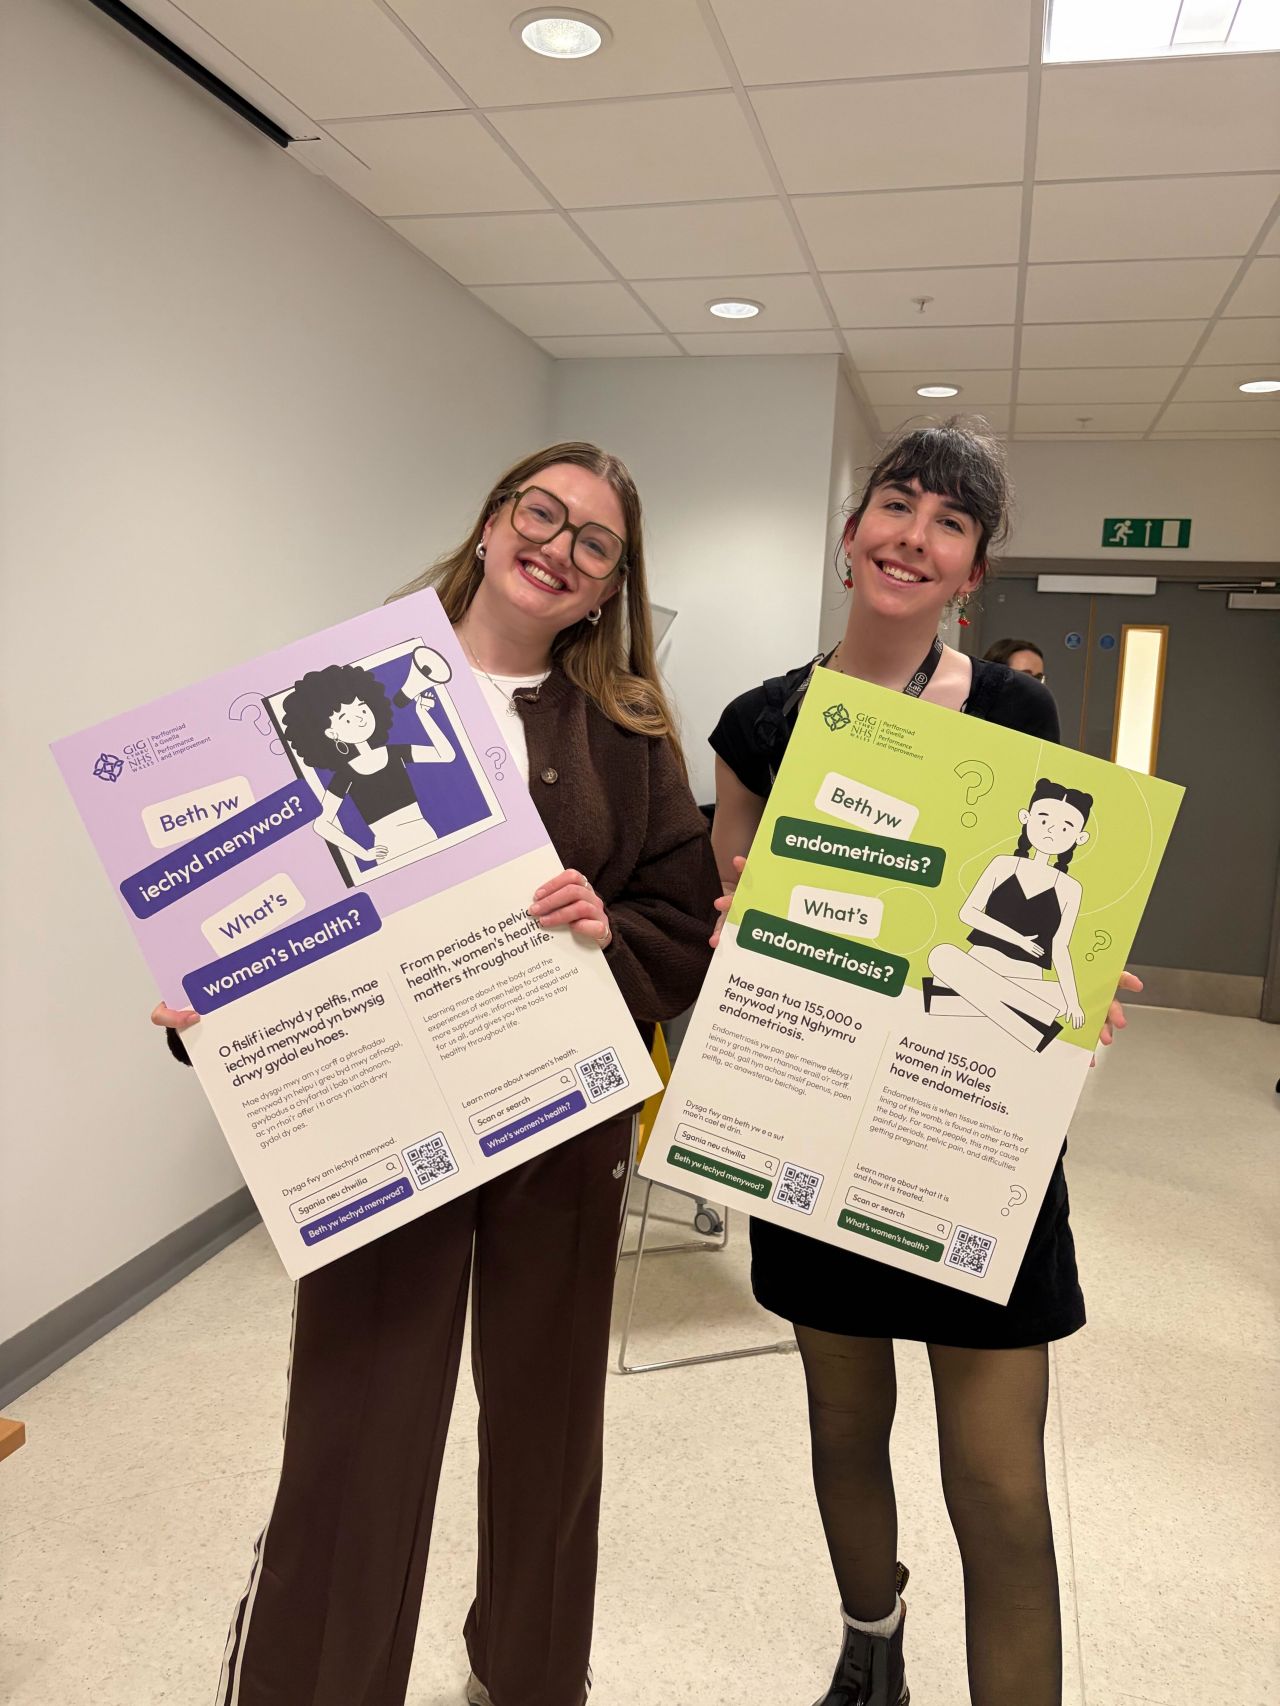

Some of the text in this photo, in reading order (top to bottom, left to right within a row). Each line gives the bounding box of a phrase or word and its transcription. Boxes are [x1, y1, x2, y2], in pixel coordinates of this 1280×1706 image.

[151, 722, 186, 742] Perfformiad
[850, 724, 873, 739] NHS
[856, 712, 877, 726] GIG
[882, 721, 916, 736] Perfformiad
[885, 728, 905, 739] Gwella
[123, 739, 147, 755] GIG
[156, 736, 194, 755] Performance
[159, 734, 180, 745] Gwella
[160, 752, 173, 761] and
[878, 734, 913, 750] Performance
[128, 752, 152, 769] NHS
[159, 796, 238, 833] Beth yw
[830, 787, 902, 828] Beth yw
[138, 796, 303, 902] iechyd menywod?
[785, 834, 931, 874] endometriosis?
[218, 894, 288, 939] What's
[804, 898, 868, 925] What's
[202, 909, 361, 996] women's health?
[399, 954, 435, 975] From
[436, 931, 482, 961] periods
[482, 925, 497, 937] to
[405, 963, 451, 989] health,
[451, 937, 505, 967] women's
[413, 933, 554, 1003] matters throughout life.
[751, 928, 894, 982] endometriosis?
[422, 958, 553, 1023] Learning more about the body and the
[728, 973, 863, 1031] Mae gan tua 155,000 o
[218, 980, 379, 1058] O fislif i iechyd y pelfis, mae
[224, 994, 385, 1073] iechyd menywod yn bwysig
[719, 1004, 804, 1041] endometriosis.
[724, 987, 856, 1044] fenywod yng Nghymru
[232, 1029, 349, 1087] drwy gydol eu hoes.
[711, 1023, 759, 1046] Endometriosis
[759, 1042, 770, 1050] yw
[770, 1046, 785, 1055] pan
[784, 1051, 800, 1060] geir
[799, 1057, 827, 1071] meinwe
[827, 1066, 850, 1081] debyg
[895, 1051, 992, 1093] women in Wales
[898, 1036, 997, 1078] Around 155,000
[241, 1097, 260, 1109] Mae
[260, 1086, 283, 1100] dysgu
[282, 1077, 300, 1090] mwy
[301, 1071, 315, 1081] am
[314, 1068, 320, 1076] y
[320, 1057, 338, 1072] corff
[345, 1037, 386, 1061] phrofiadau
[461, 1095, 484, 1109] Learn
[483, 1085, 503, 1098] more
[503, 1073, 524, 1089] about
[523, 1059, 555, 1078] women's
[889, 1062, 1009, 1115] have endometriosis.
[477, 1096, 531, 1127] Scan or search
[486, 1102, 571, 1149] What's women's health?
[882, 1085, 931, 1109] Endometriosis
[939, 1108, 958, 1118] when
[958, 1114, 979, 1126] tissue
[978, 1122, 1003, 1134] similar
[1003, 1129, 1011, 1138] to
[1011, 1133, 1024, 1142] the
[260, 1122, 308, 1150] gydol dy oes.
[681, 1130, 746, 1160] Sgania neu chwilia
[281, 1136, 397, 1197] Dysga fwy am iechyd menywod.
[674, 1152, 765, 1192] Beth yw iechyd menywod?
[856, 1162, 950, 1202] Learn more about what it is
[298, 1177, 368, 1215] Sgania neu chwilia
[852, 1193, 871, 1206] Scan
[880, 1205, 905, 1219] search
[853, 1172, 868, 1182] and
[867, 1176, 884, 1187] how
[889, 1184, 896, 1192] is
[896, 1187, 924, 1203] treated.
[308, 1185, 404, 1238] Beth yw iechyd menywod?
[845, 1216, 930, 1252] What's women's health?
